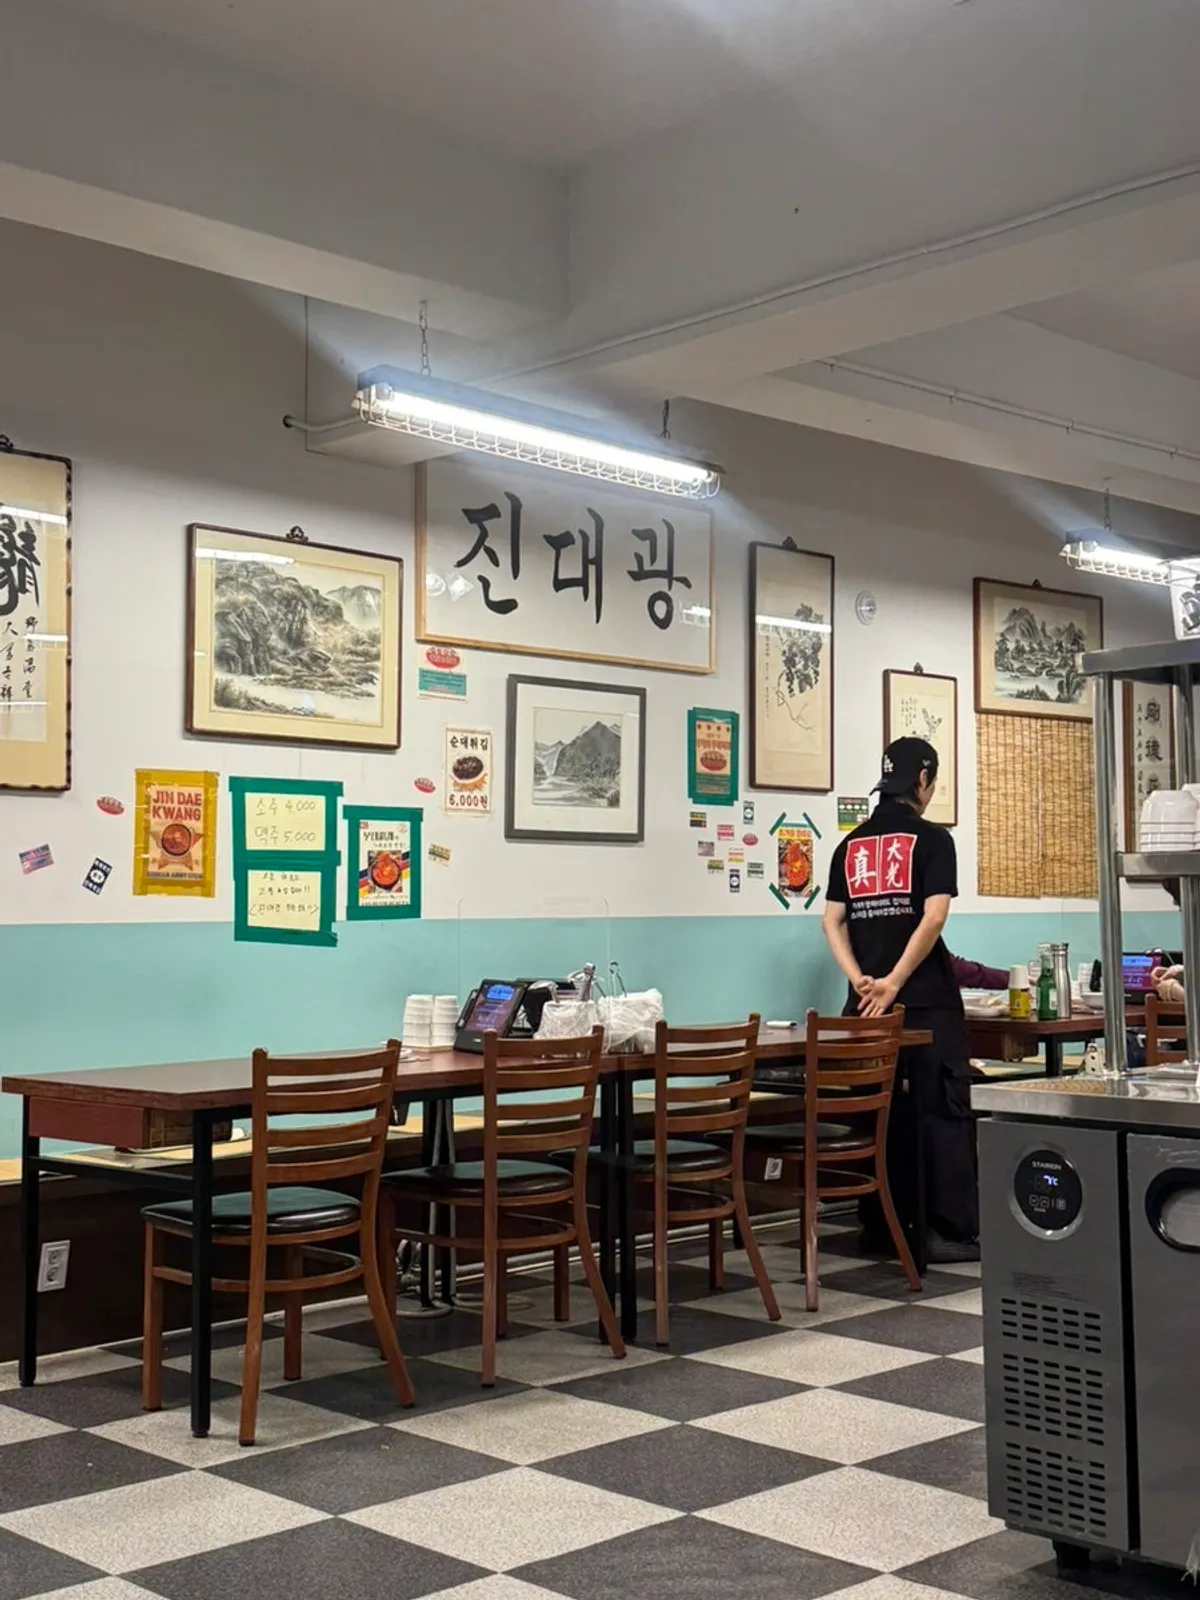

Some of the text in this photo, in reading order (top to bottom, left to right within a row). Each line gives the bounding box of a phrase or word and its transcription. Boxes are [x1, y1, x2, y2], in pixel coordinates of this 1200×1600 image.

[453, 490, 692, 630] 진대광
[450, 735, 488, 751] 순대튀김
[152, 790, 203, 806] JIN DAE
[255, 797, 278, 816] 소주
[152, 806, 202, 821] KWANG
[254, 825, 279, 846] 맥주
